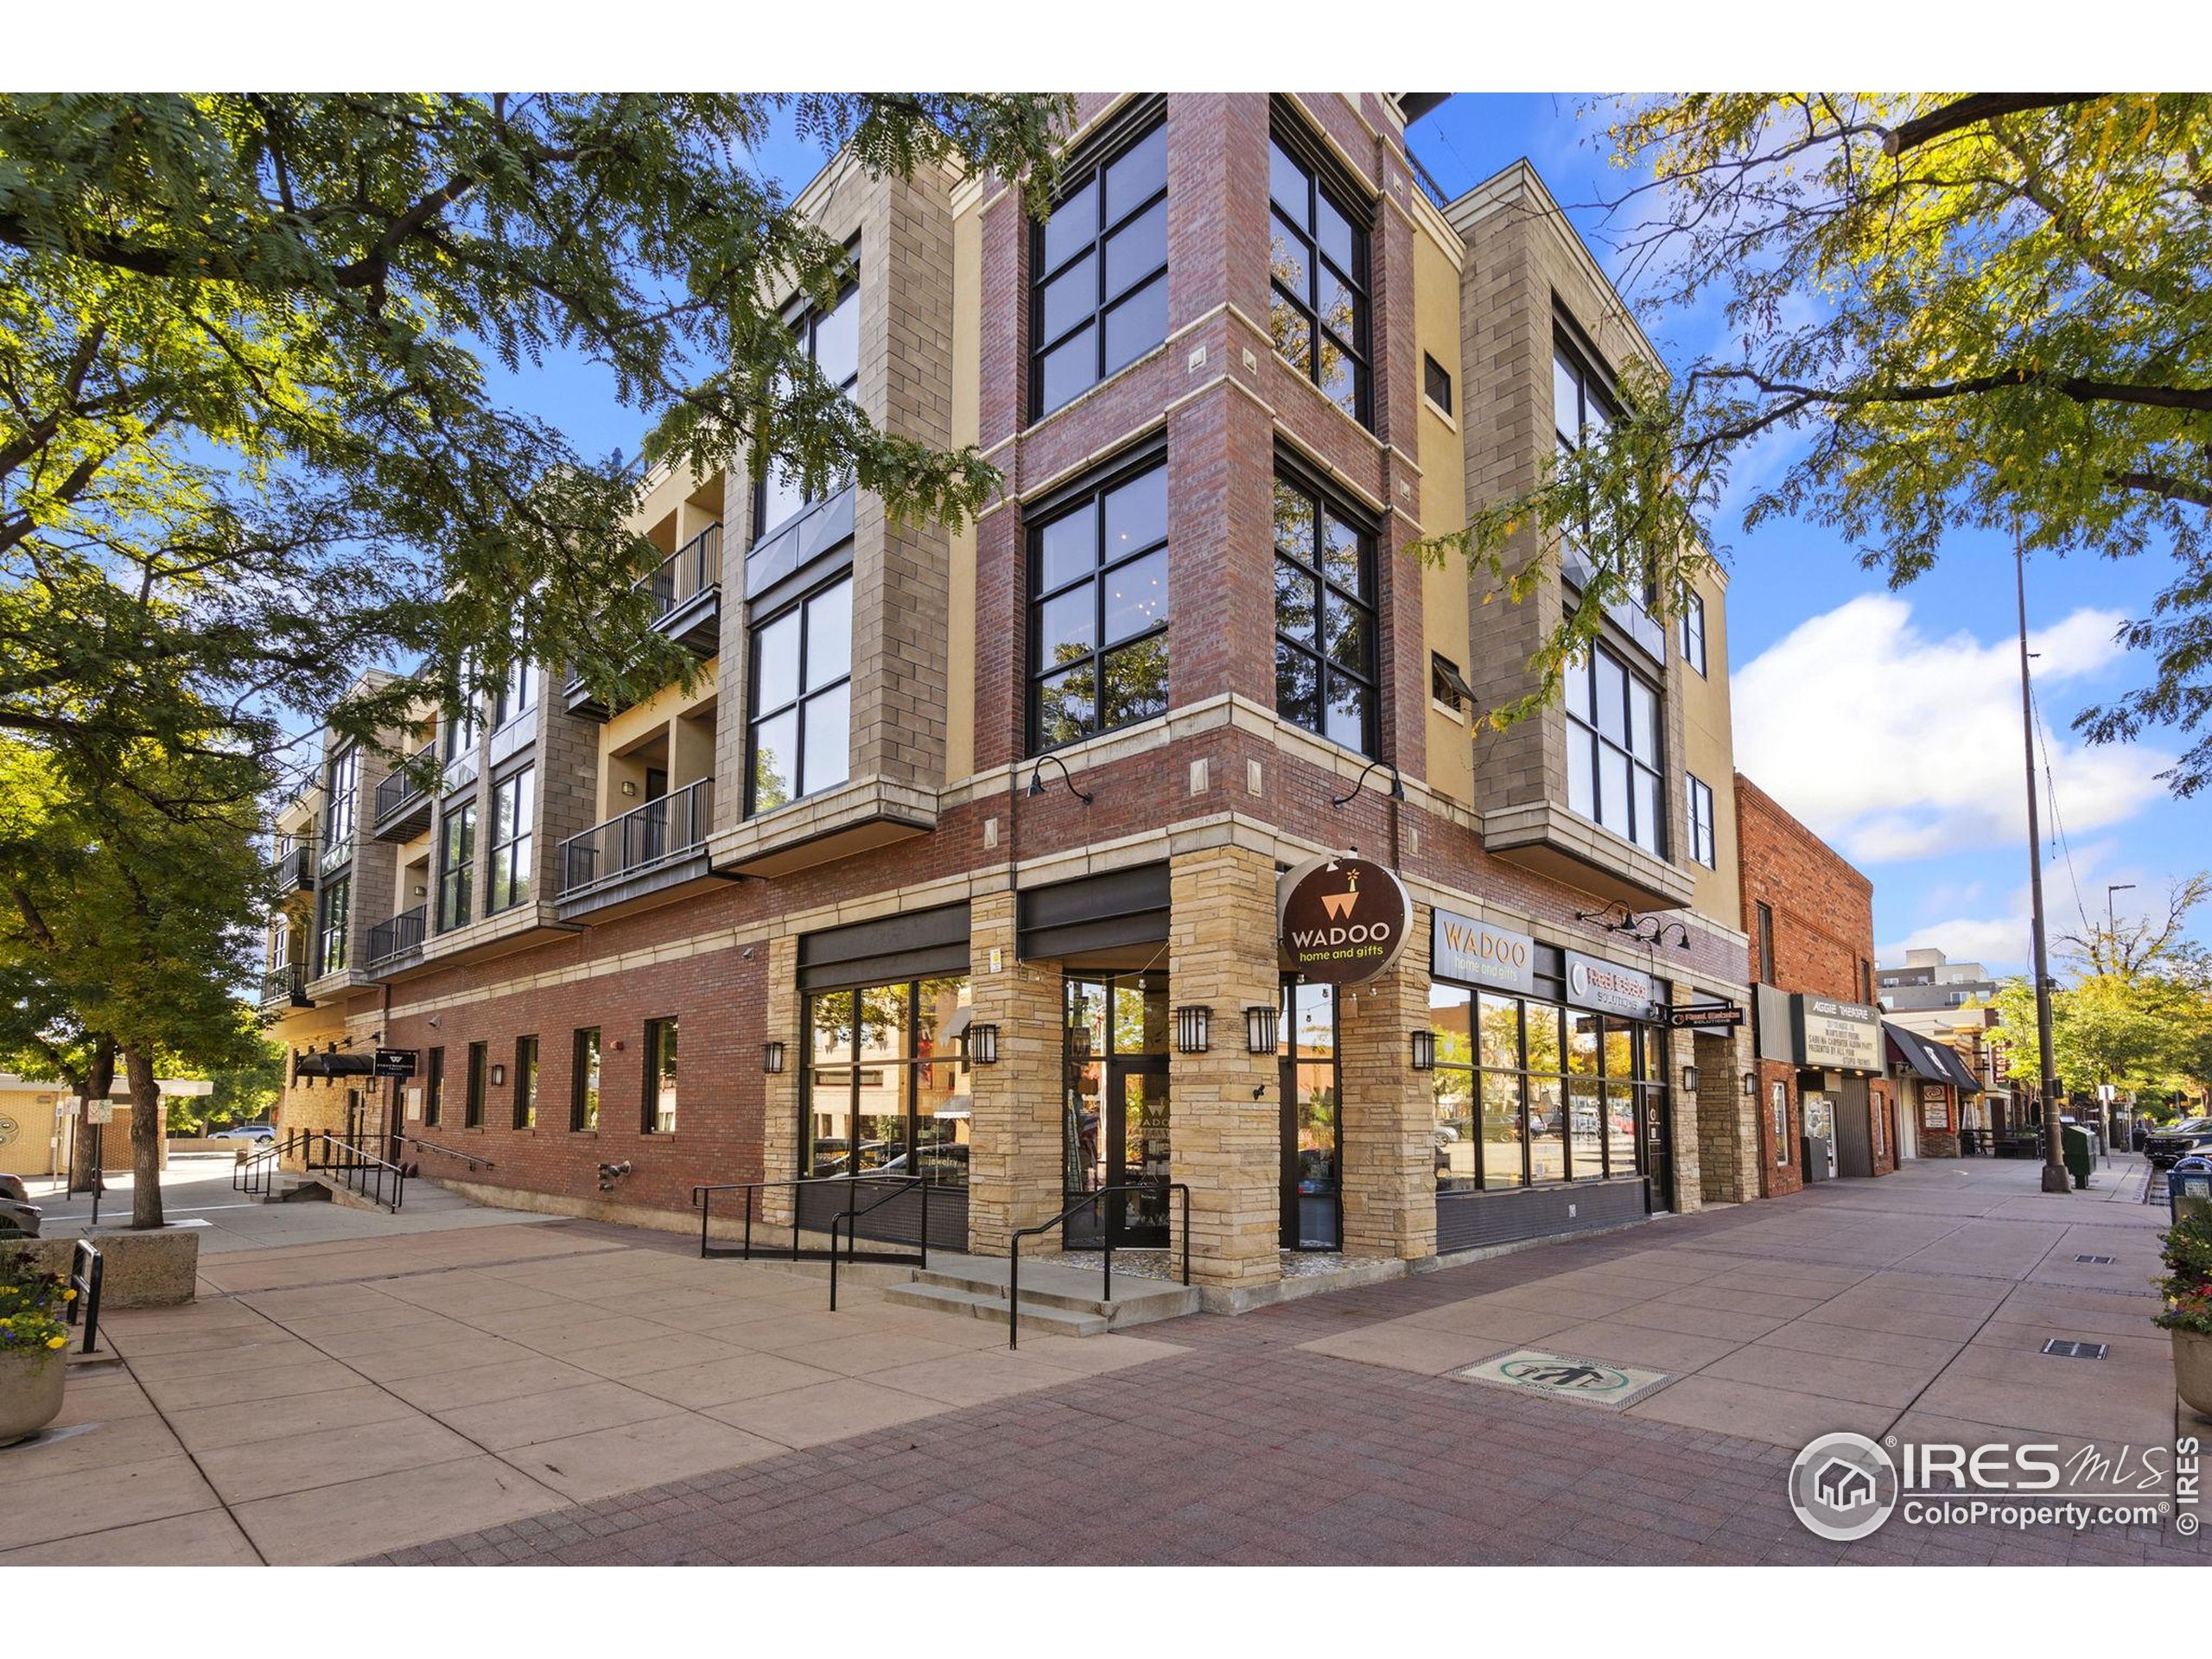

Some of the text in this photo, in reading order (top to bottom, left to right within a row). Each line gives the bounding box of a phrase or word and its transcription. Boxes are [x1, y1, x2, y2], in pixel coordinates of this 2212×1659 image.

[1292, 922, 1390, 949] WADOO
[1443, 921, 1527, 969] WADOO
[1300, 945, 1383, 963] home and gifts
[1455, 956, 1518, 982] home and gifts
[1586, 967, 1647, 1000] Real Estate
[1597, 991, 1638, 1010] SOLUTIONS
[1813, 1001, 1837, 1015] AGGIE
[1685, 1011, 1740, 1021] Real Estate
